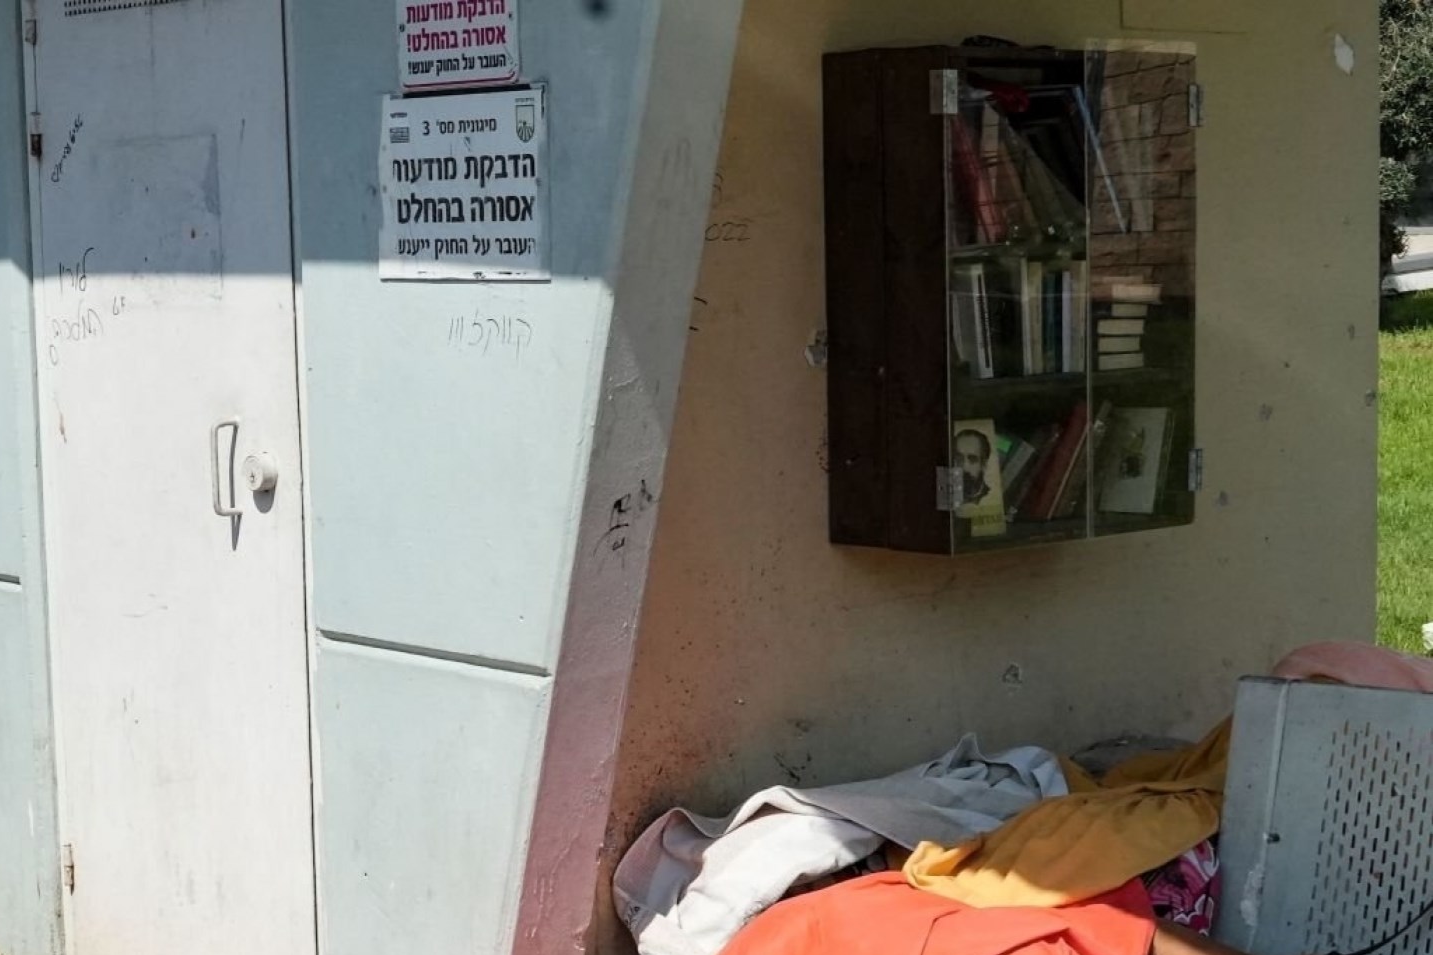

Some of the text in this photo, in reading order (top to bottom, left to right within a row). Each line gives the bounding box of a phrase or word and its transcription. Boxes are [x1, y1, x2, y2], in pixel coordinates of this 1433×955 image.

[406, 2, 453, 24] מודעות
[407, 25, 506, 52] אסורה בהחלט!
[436, 58, 460, 76] החוק
[461, 53, 475, 70] על
[477, 54, 506, 69] העובר
[422, 120, 430, 136] 3
[458, 118, 496, 134] מיגונית
[464, 153, 535, 188] הדבקת
[397, 193, 535, 224] אסורה בהחלט
[434, 238, 468, 260] החוק
[472, 235, 490, 256] על
